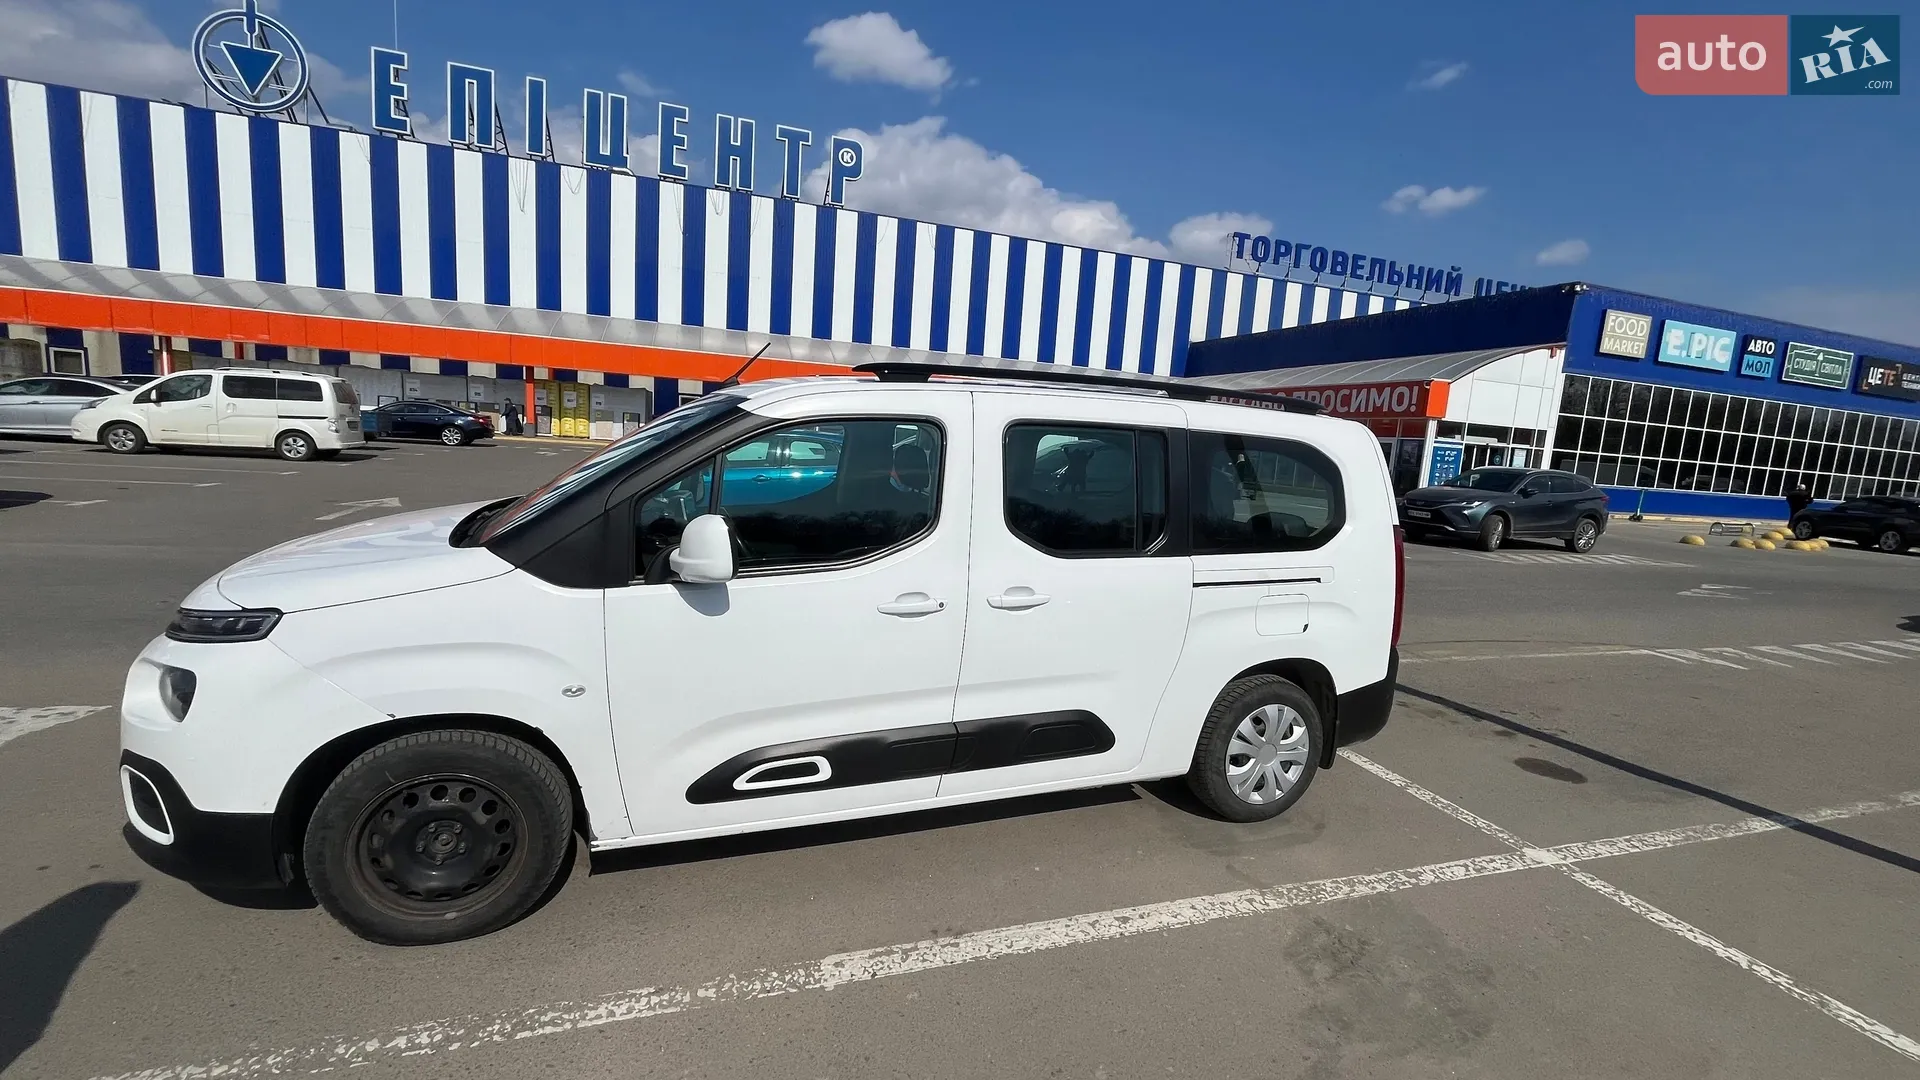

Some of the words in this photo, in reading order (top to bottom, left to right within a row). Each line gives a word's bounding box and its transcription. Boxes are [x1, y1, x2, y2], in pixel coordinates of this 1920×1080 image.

[370, 46, 863, 206] ЕПІЦЕНТР
[1234, 232, 1463, 296] ТОРГОВЕЛЬНИЙ
[1607, 315, 1647, 336] FOOD
[1603, 337, 1645, 355] MARKET
[1666, 328, 1732, 364] E.PIC
[1747, 339, 1775, 355] АВТО
[1744, 361, 1771, 374] МОЛ
